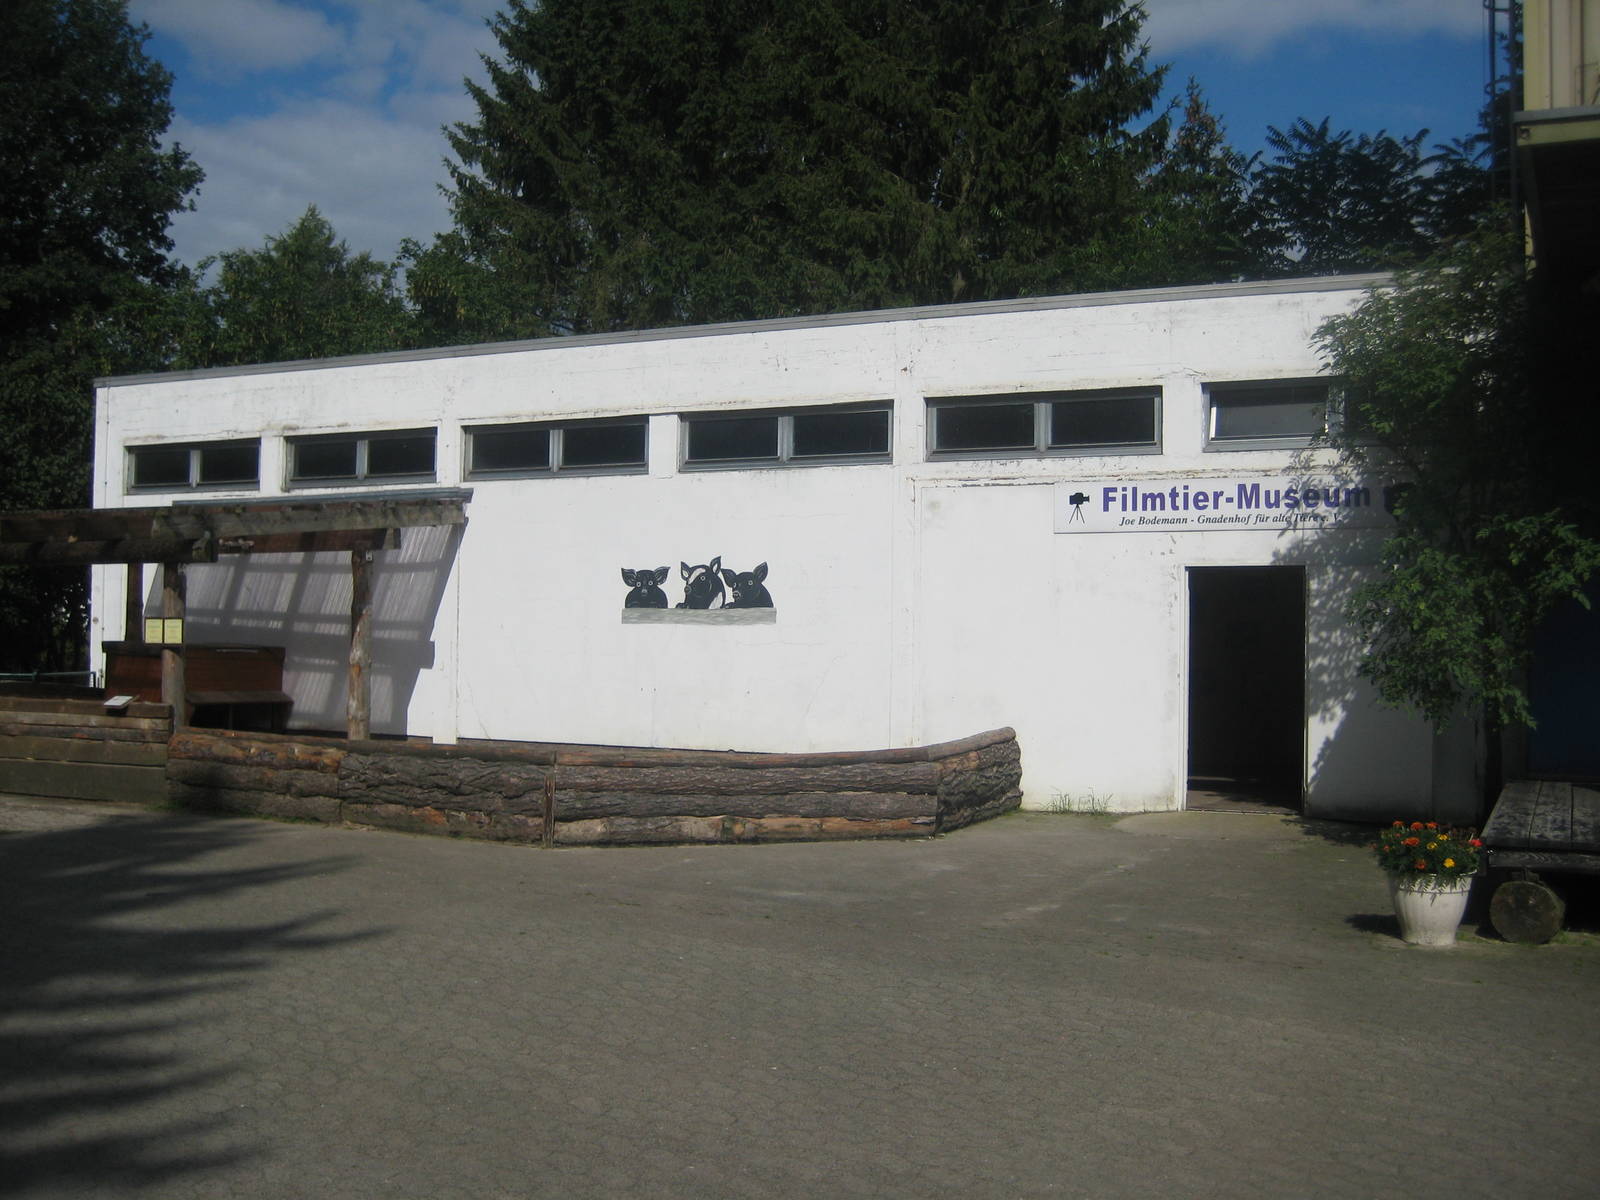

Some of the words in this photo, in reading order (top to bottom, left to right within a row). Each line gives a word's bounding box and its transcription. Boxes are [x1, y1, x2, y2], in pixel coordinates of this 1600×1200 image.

[1102, 483, 1371, 512] Filmtier-Museum
[1119, 516, 1136, 527] Joe
[1138, 515, 1188, 525] Bodemann
[1197, 514, 1252, 526] Gnadenhof
[1253, 513, 1271, 525] für
[1272, 513, 1291, 524] alte
